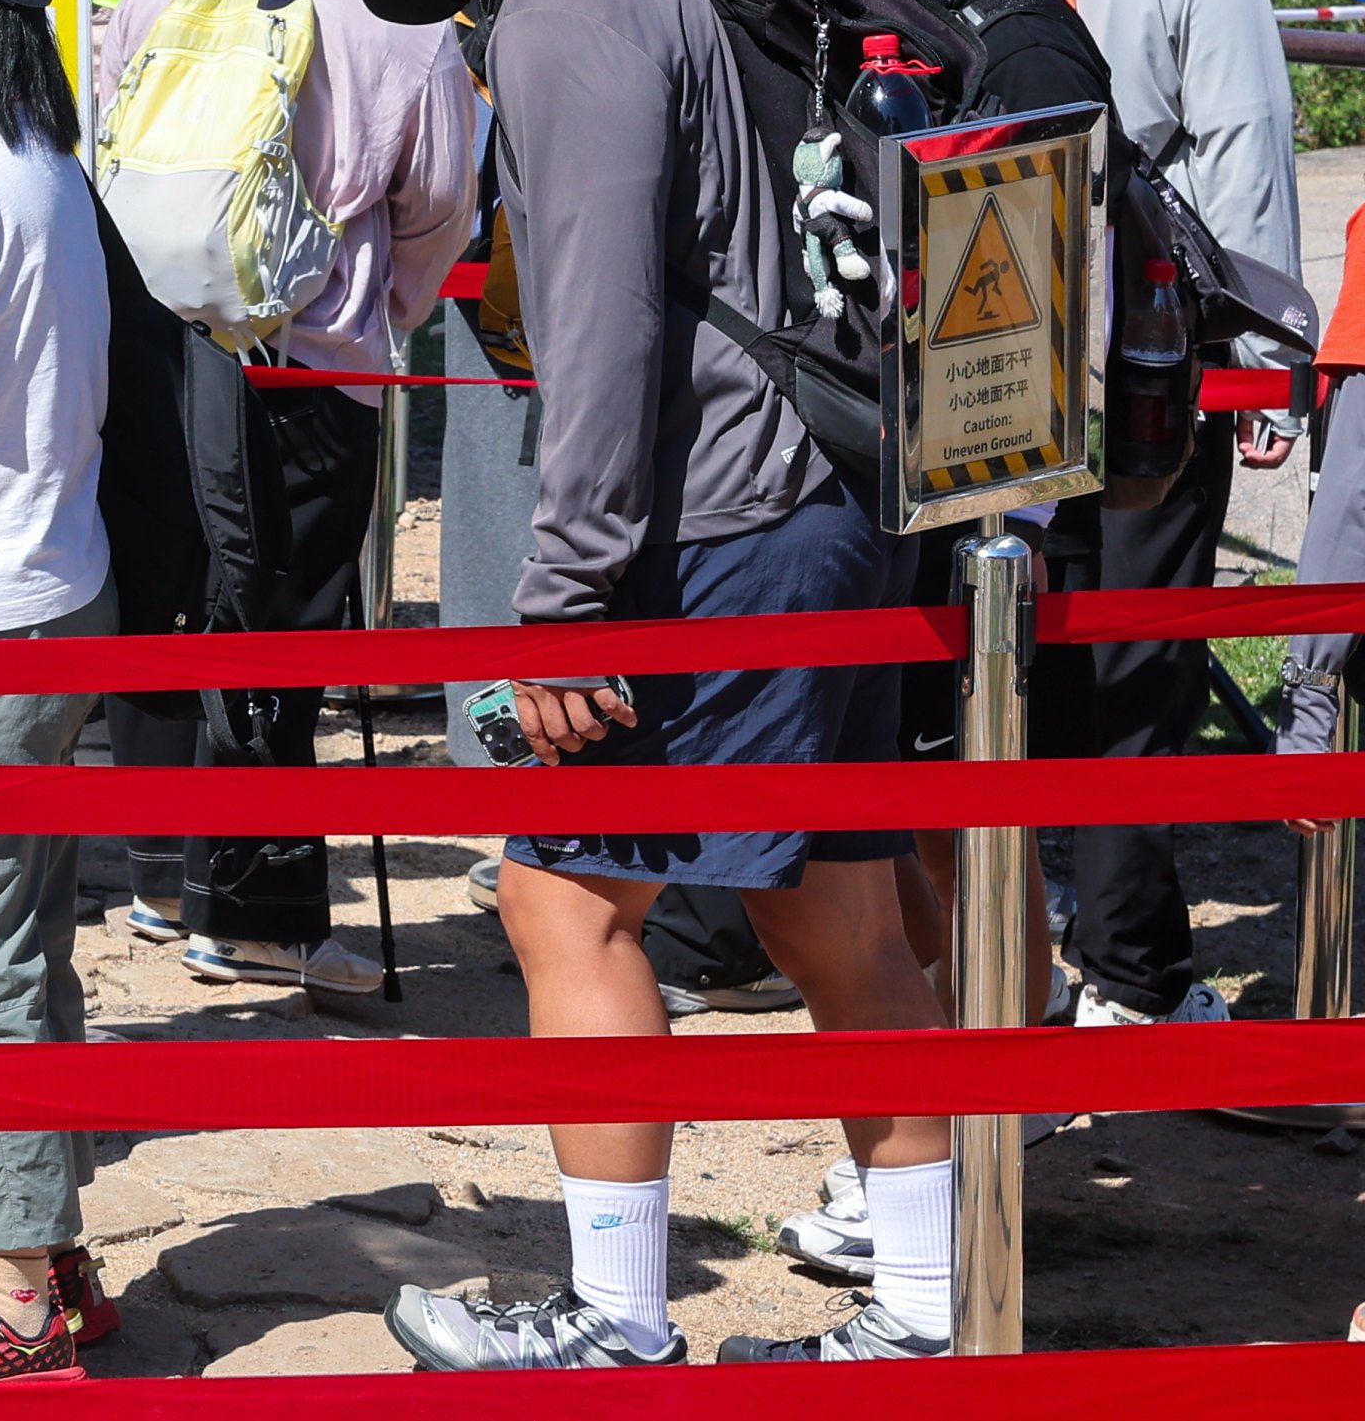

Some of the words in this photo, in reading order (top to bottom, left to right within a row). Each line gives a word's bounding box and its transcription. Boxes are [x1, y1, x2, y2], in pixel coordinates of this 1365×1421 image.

[945, 348, 1033, 384] 小心地面不平
[949, 379, 1029, 412] 小心地面不平
[963, 414, 1012, 434] Caution:
[943, 435, 988, 461] Uneven
[990, 428, 1033, 452] Ground
